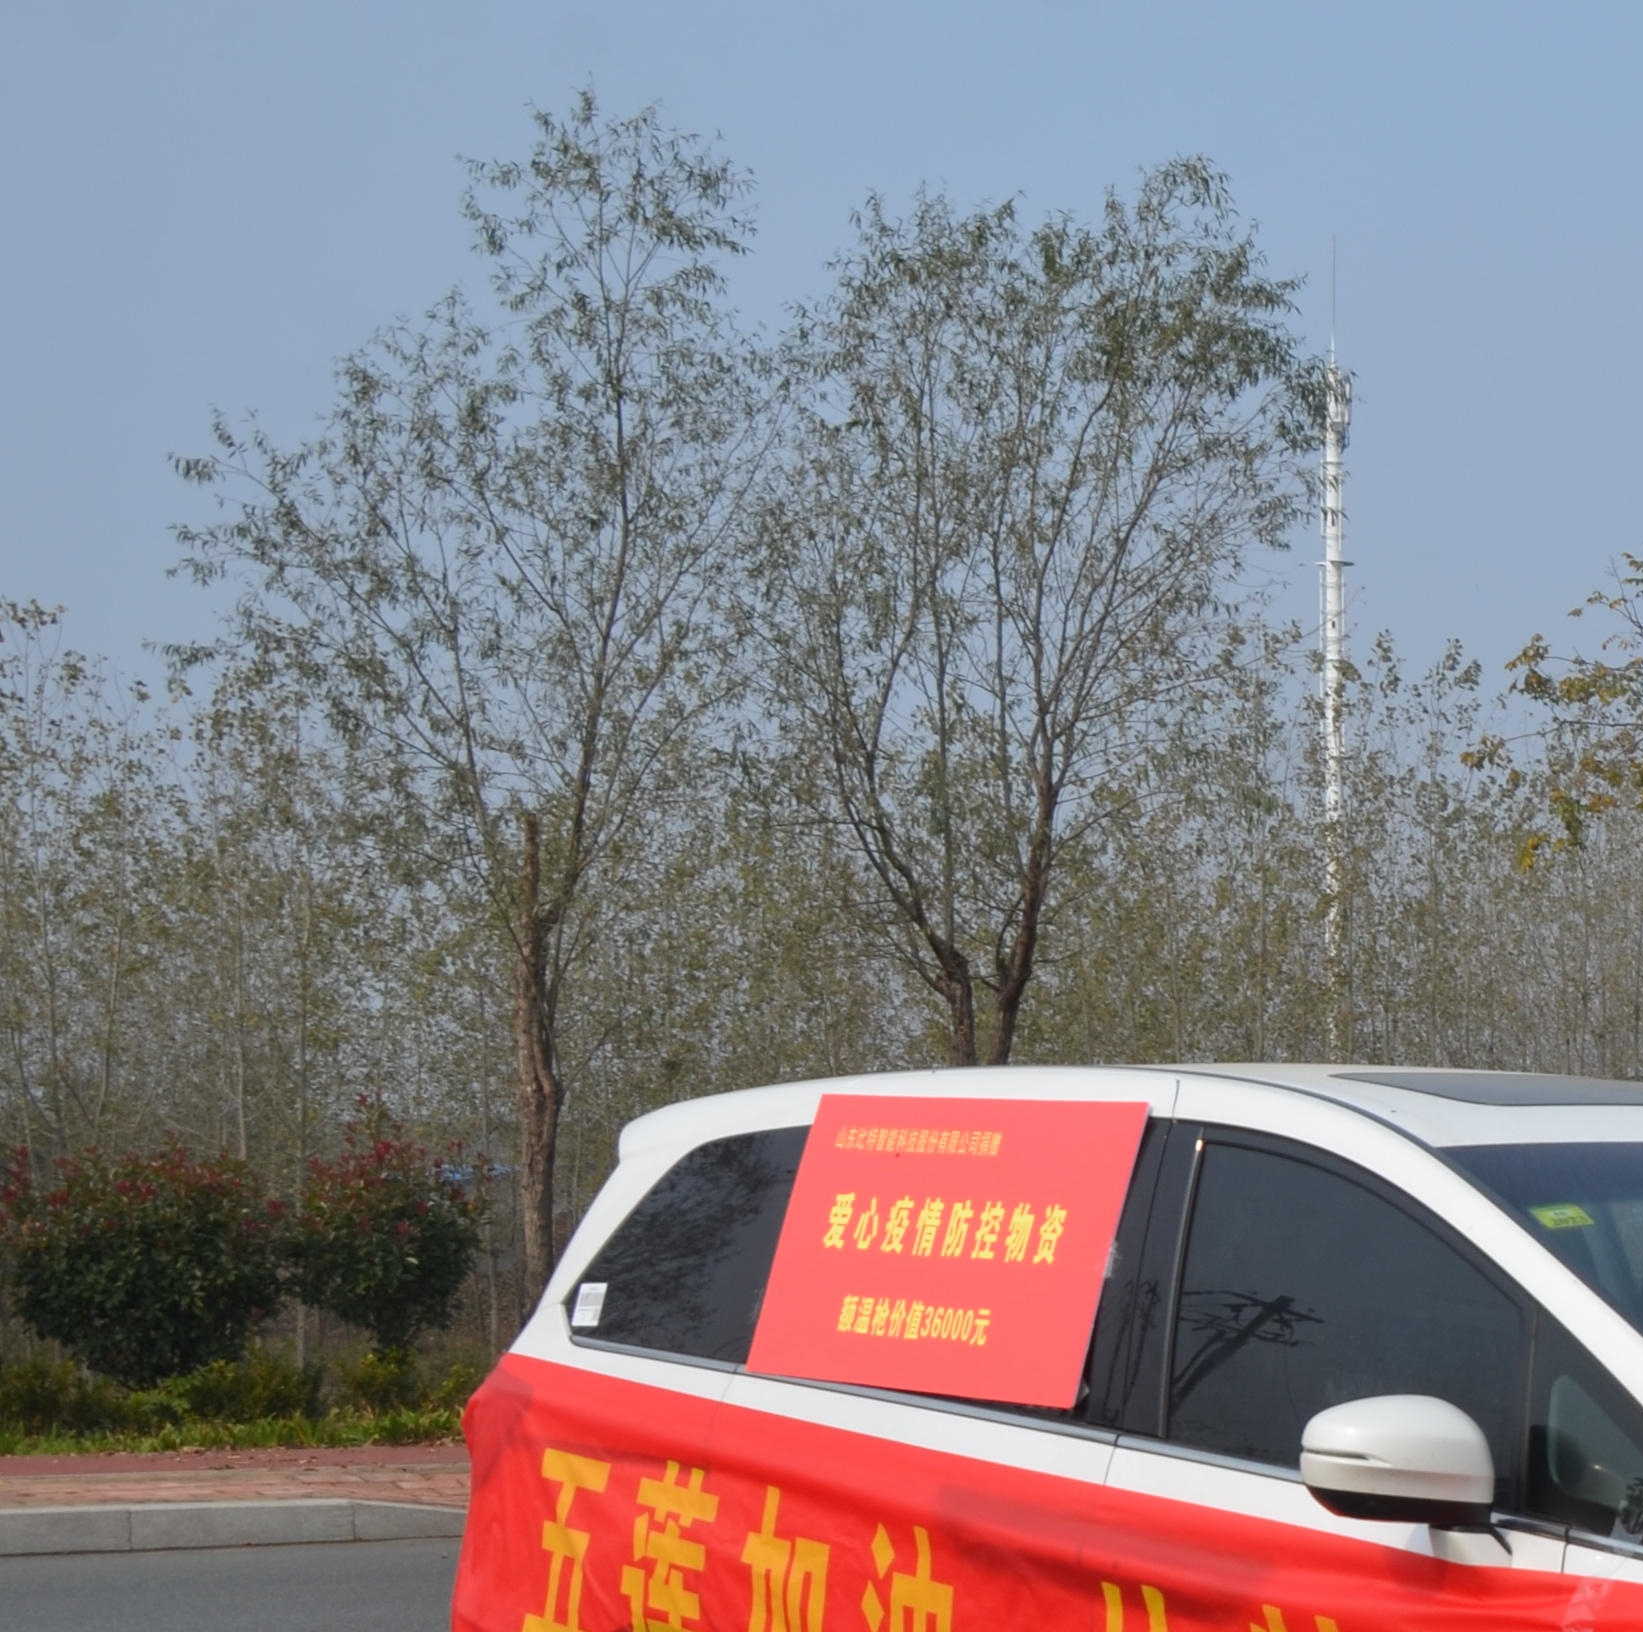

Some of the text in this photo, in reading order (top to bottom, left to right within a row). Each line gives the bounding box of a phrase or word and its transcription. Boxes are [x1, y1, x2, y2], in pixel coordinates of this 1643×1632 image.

[822, 1193, 1067, 1264] 爱心疫情防控物资
[836, 1294, 991, 1346] 额温枪价值36000元
